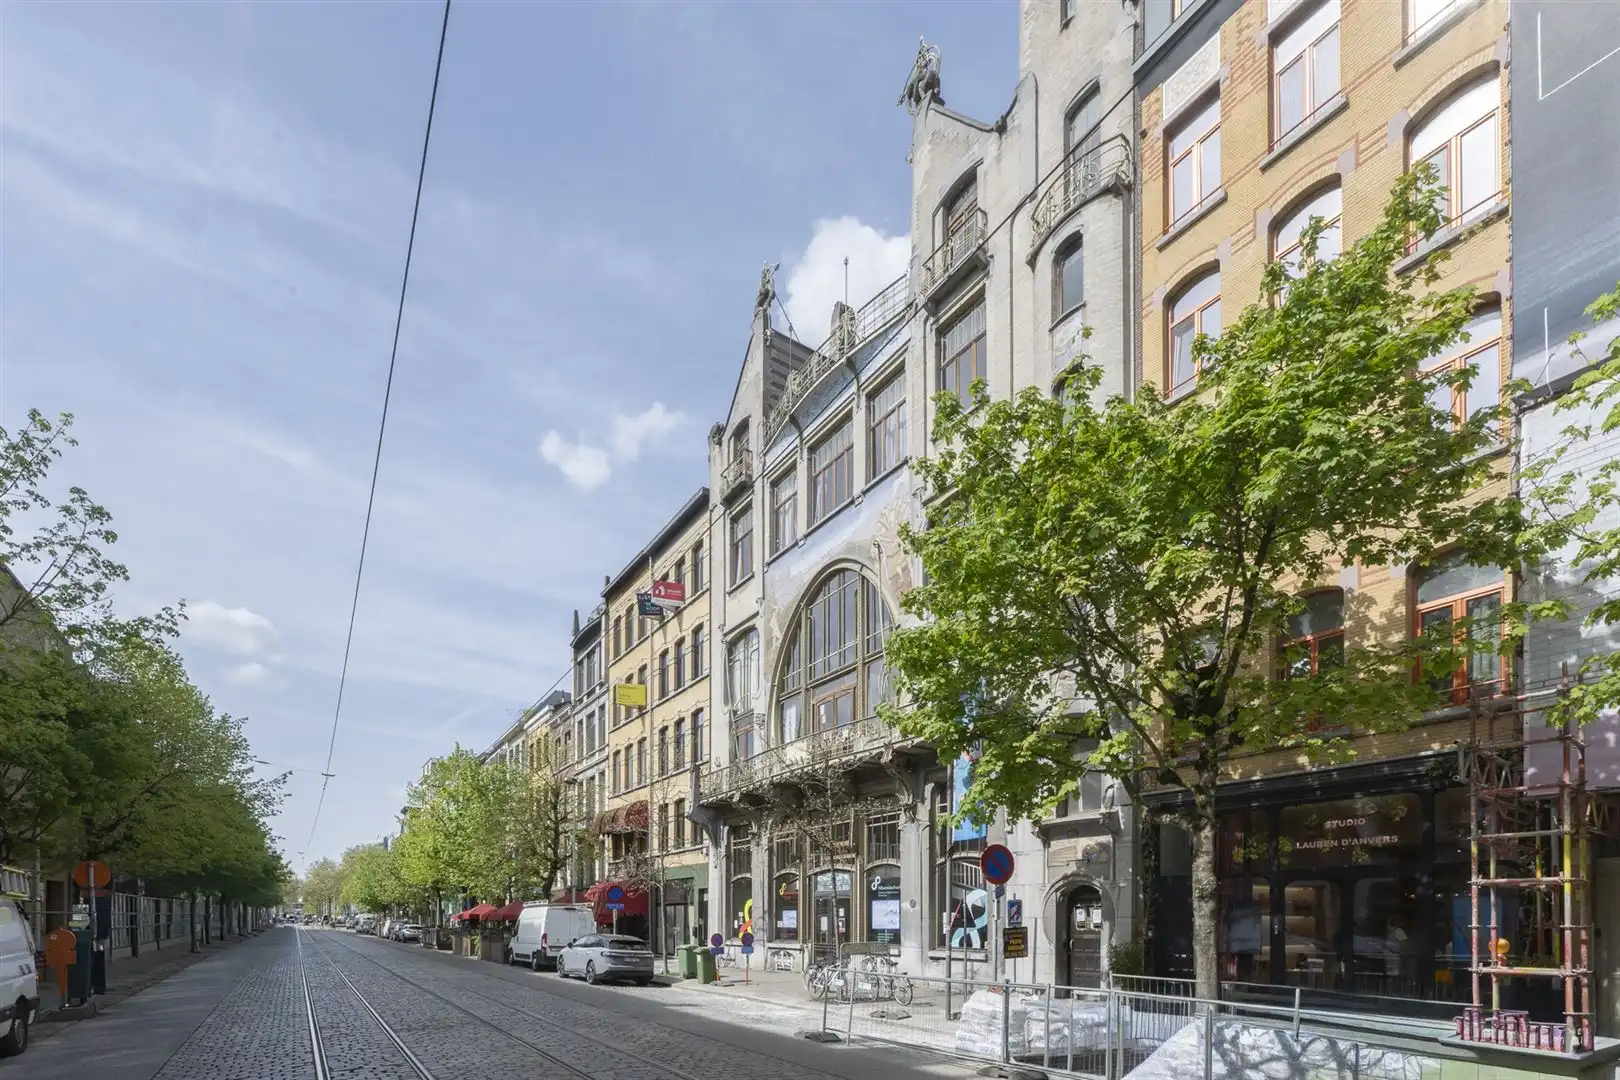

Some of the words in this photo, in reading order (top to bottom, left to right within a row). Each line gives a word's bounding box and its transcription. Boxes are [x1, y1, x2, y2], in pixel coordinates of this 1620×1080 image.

[1324, 818, 1366, 829] STUDIO
[1296, 839, 1338, 849] LAUREN
[1341, 835, 1399, 847] D'ANVERS
